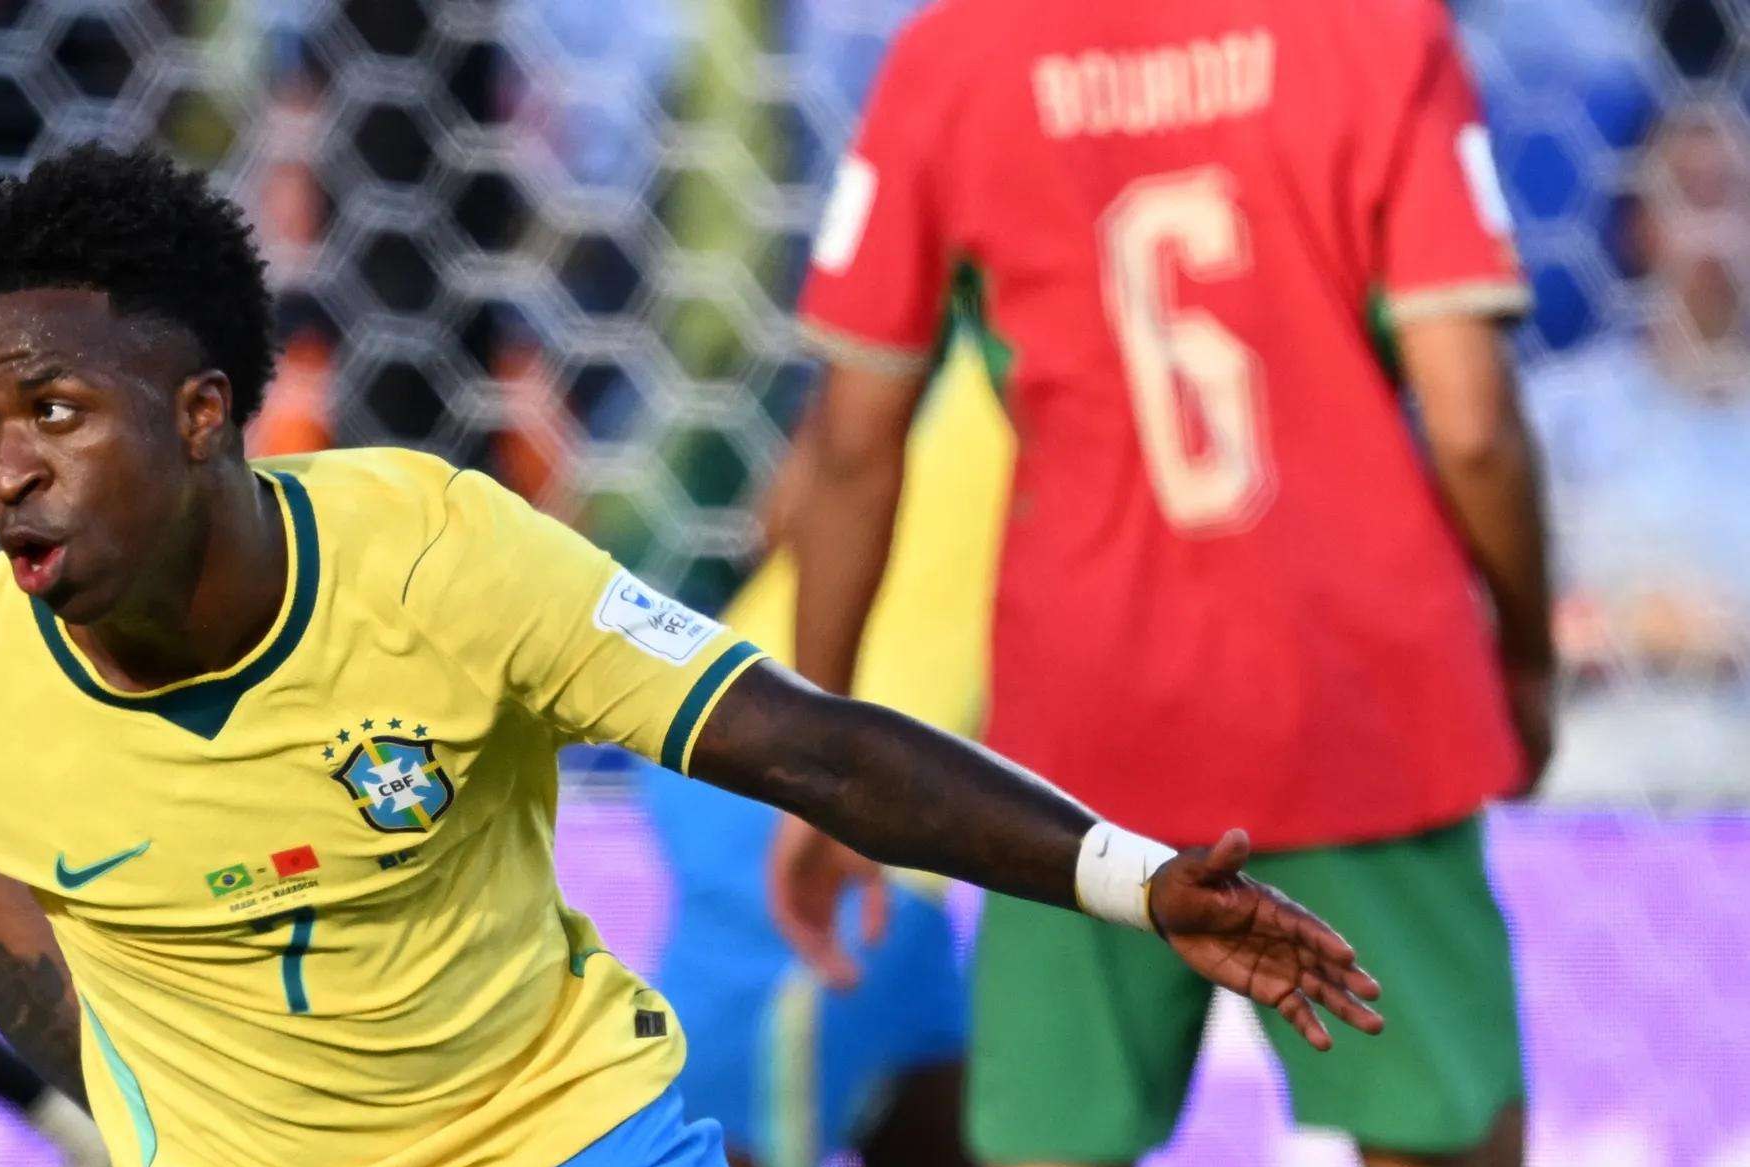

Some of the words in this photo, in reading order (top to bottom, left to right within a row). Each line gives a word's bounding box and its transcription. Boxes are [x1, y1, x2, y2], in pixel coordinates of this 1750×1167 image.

[1097, 163, 1278, 538] 6
[378, 774, 415, 797] CBF
[249, 906, 317, 1014] 7
